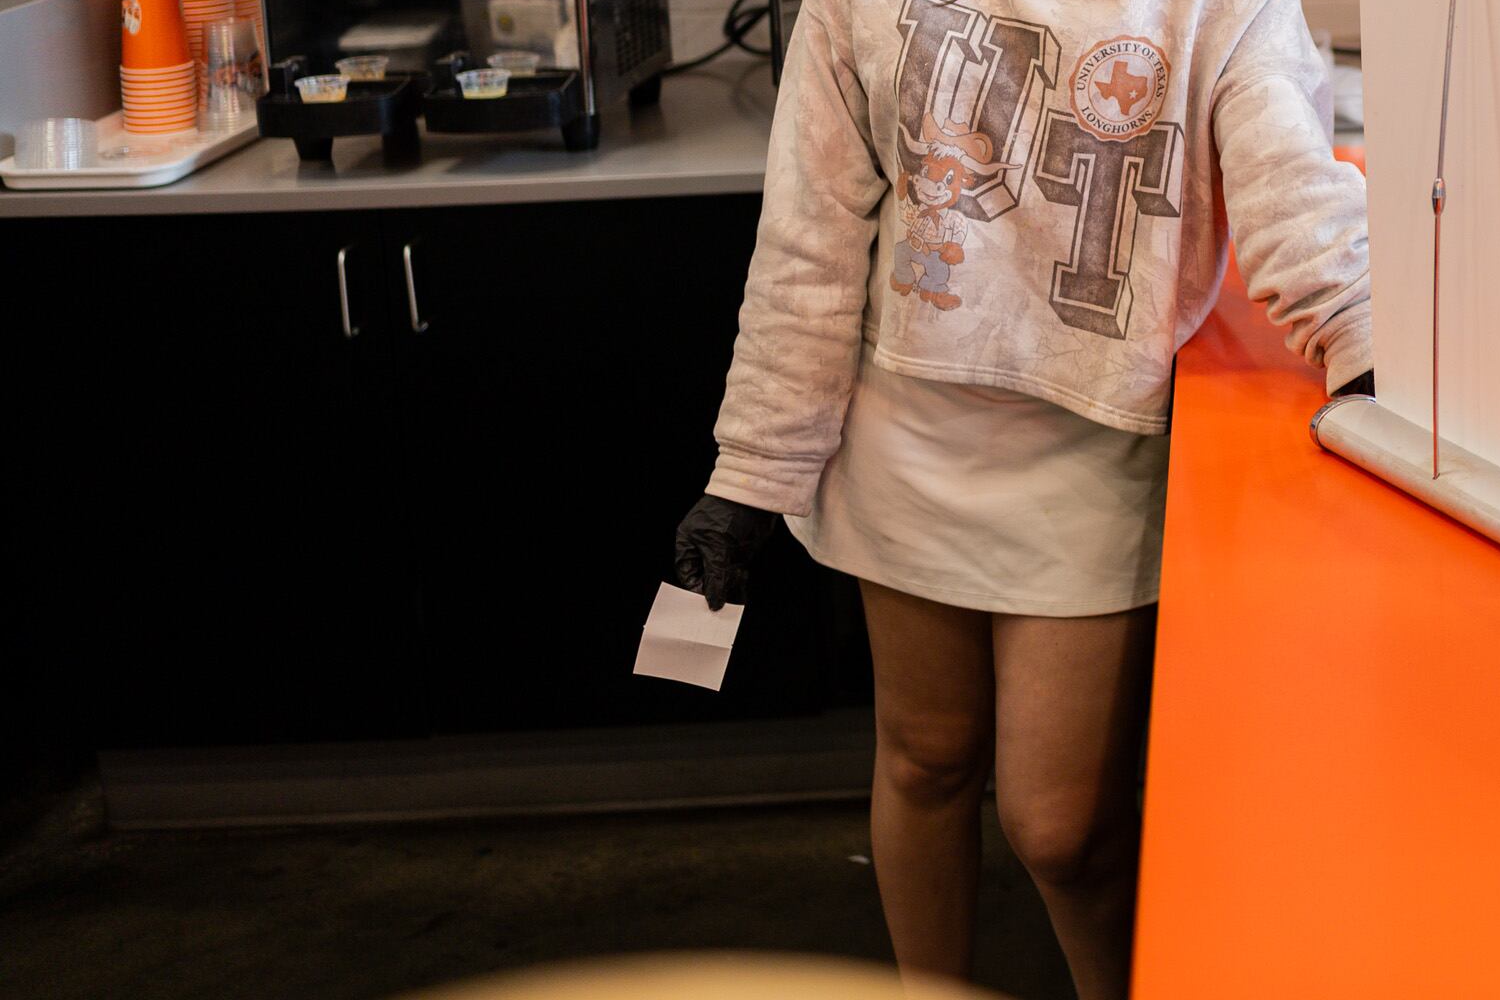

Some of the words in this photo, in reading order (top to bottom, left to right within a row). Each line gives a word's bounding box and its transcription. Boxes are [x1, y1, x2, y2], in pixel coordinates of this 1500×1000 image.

[1077, 43, 1141, 91] UNIVERSITY
[1142, 47, 1157, 60] OF
[1153, 57, 1167, 98] TEXAS
[1082, 106, 1153, 133] LONGHORNS
